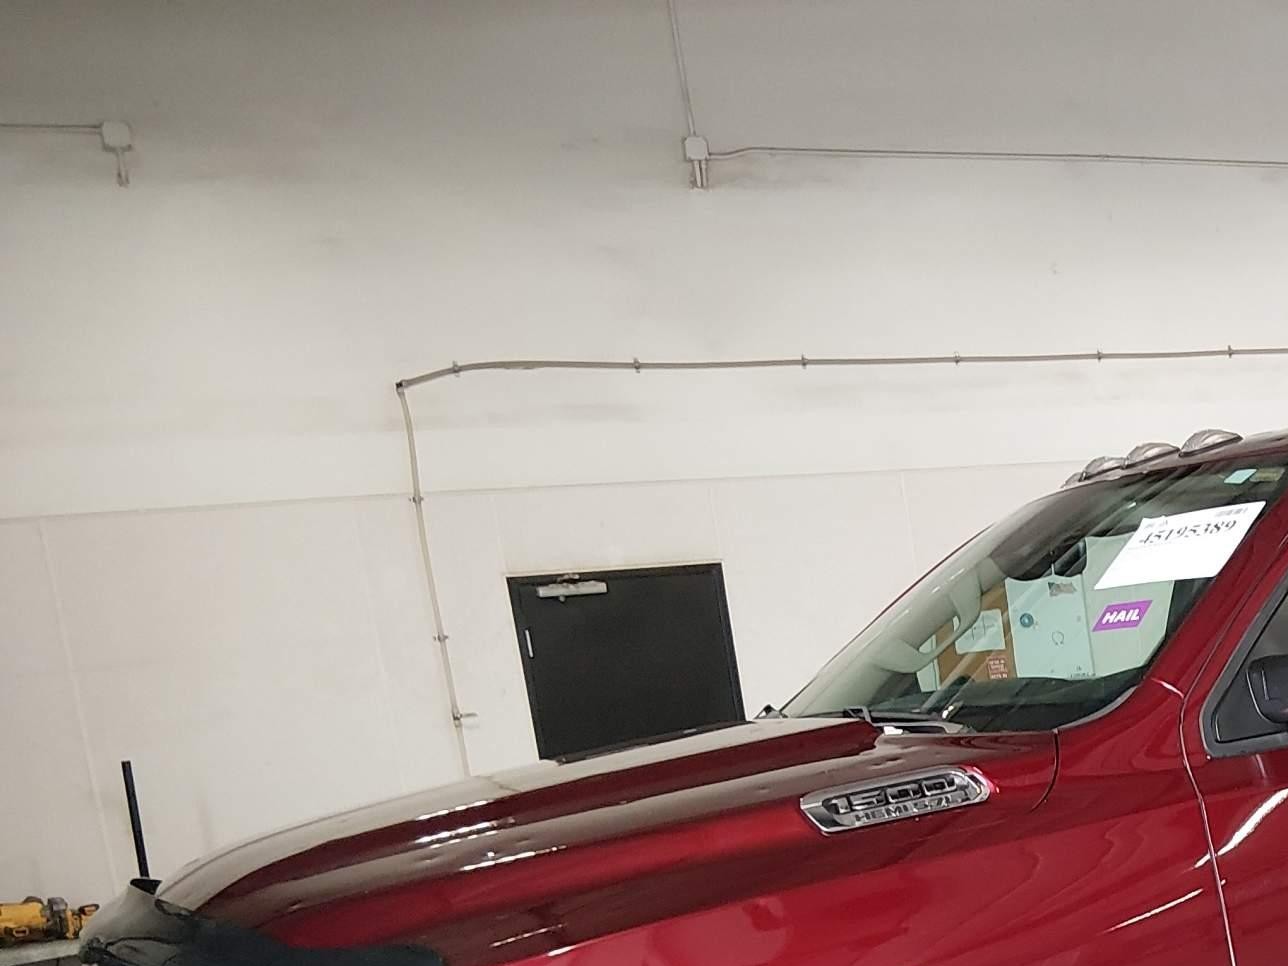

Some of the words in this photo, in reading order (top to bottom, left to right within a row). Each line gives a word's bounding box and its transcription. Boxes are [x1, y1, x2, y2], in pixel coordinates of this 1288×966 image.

[1139, 520, 1237, 545] 45195389
[1101, 608, 1140, 625] HAIL
[829, 774, 958, 814] 1500
[854, 803, 910, 821] HEMI
